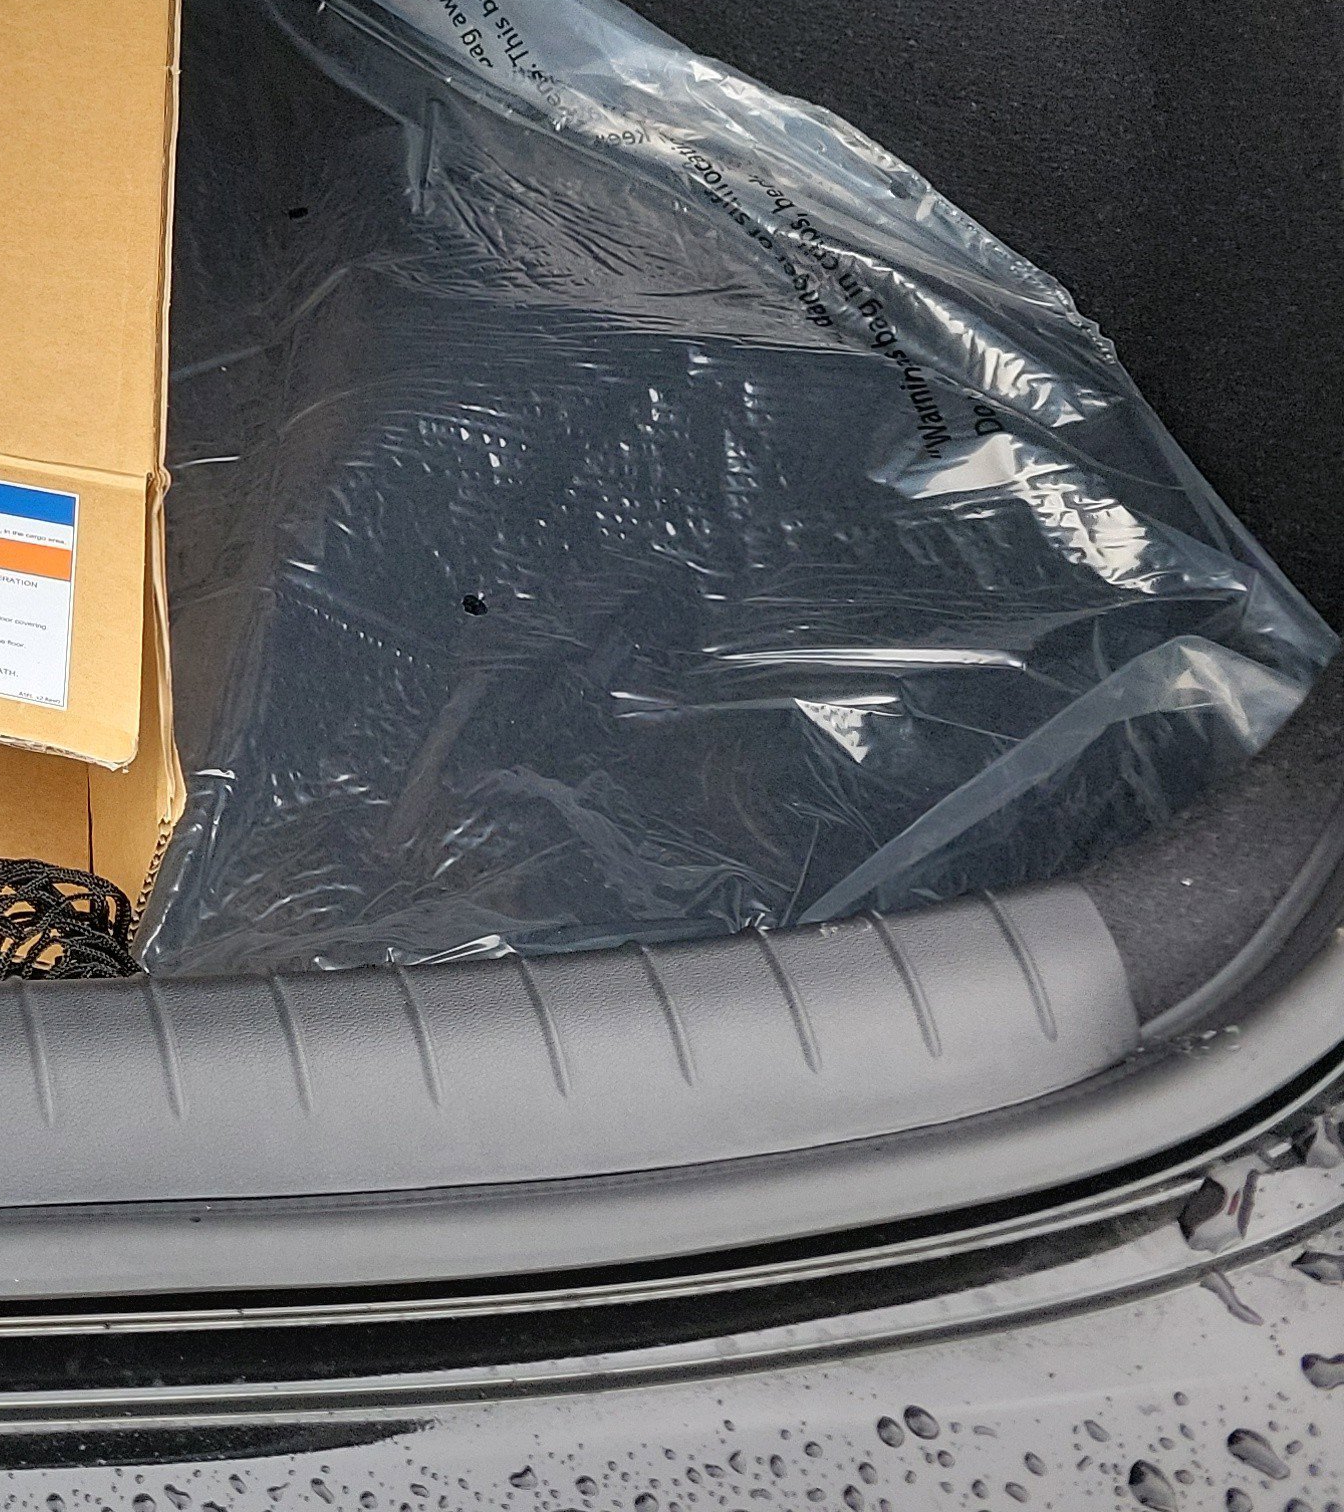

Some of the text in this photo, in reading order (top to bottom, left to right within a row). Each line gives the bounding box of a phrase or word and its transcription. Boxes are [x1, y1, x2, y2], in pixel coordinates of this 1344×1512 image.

[495, 16, 530, 68] This
[838, 272, 863, 302] in
[858, 297, 898, 349] bag
[973, 404, 1005, 437] Do
